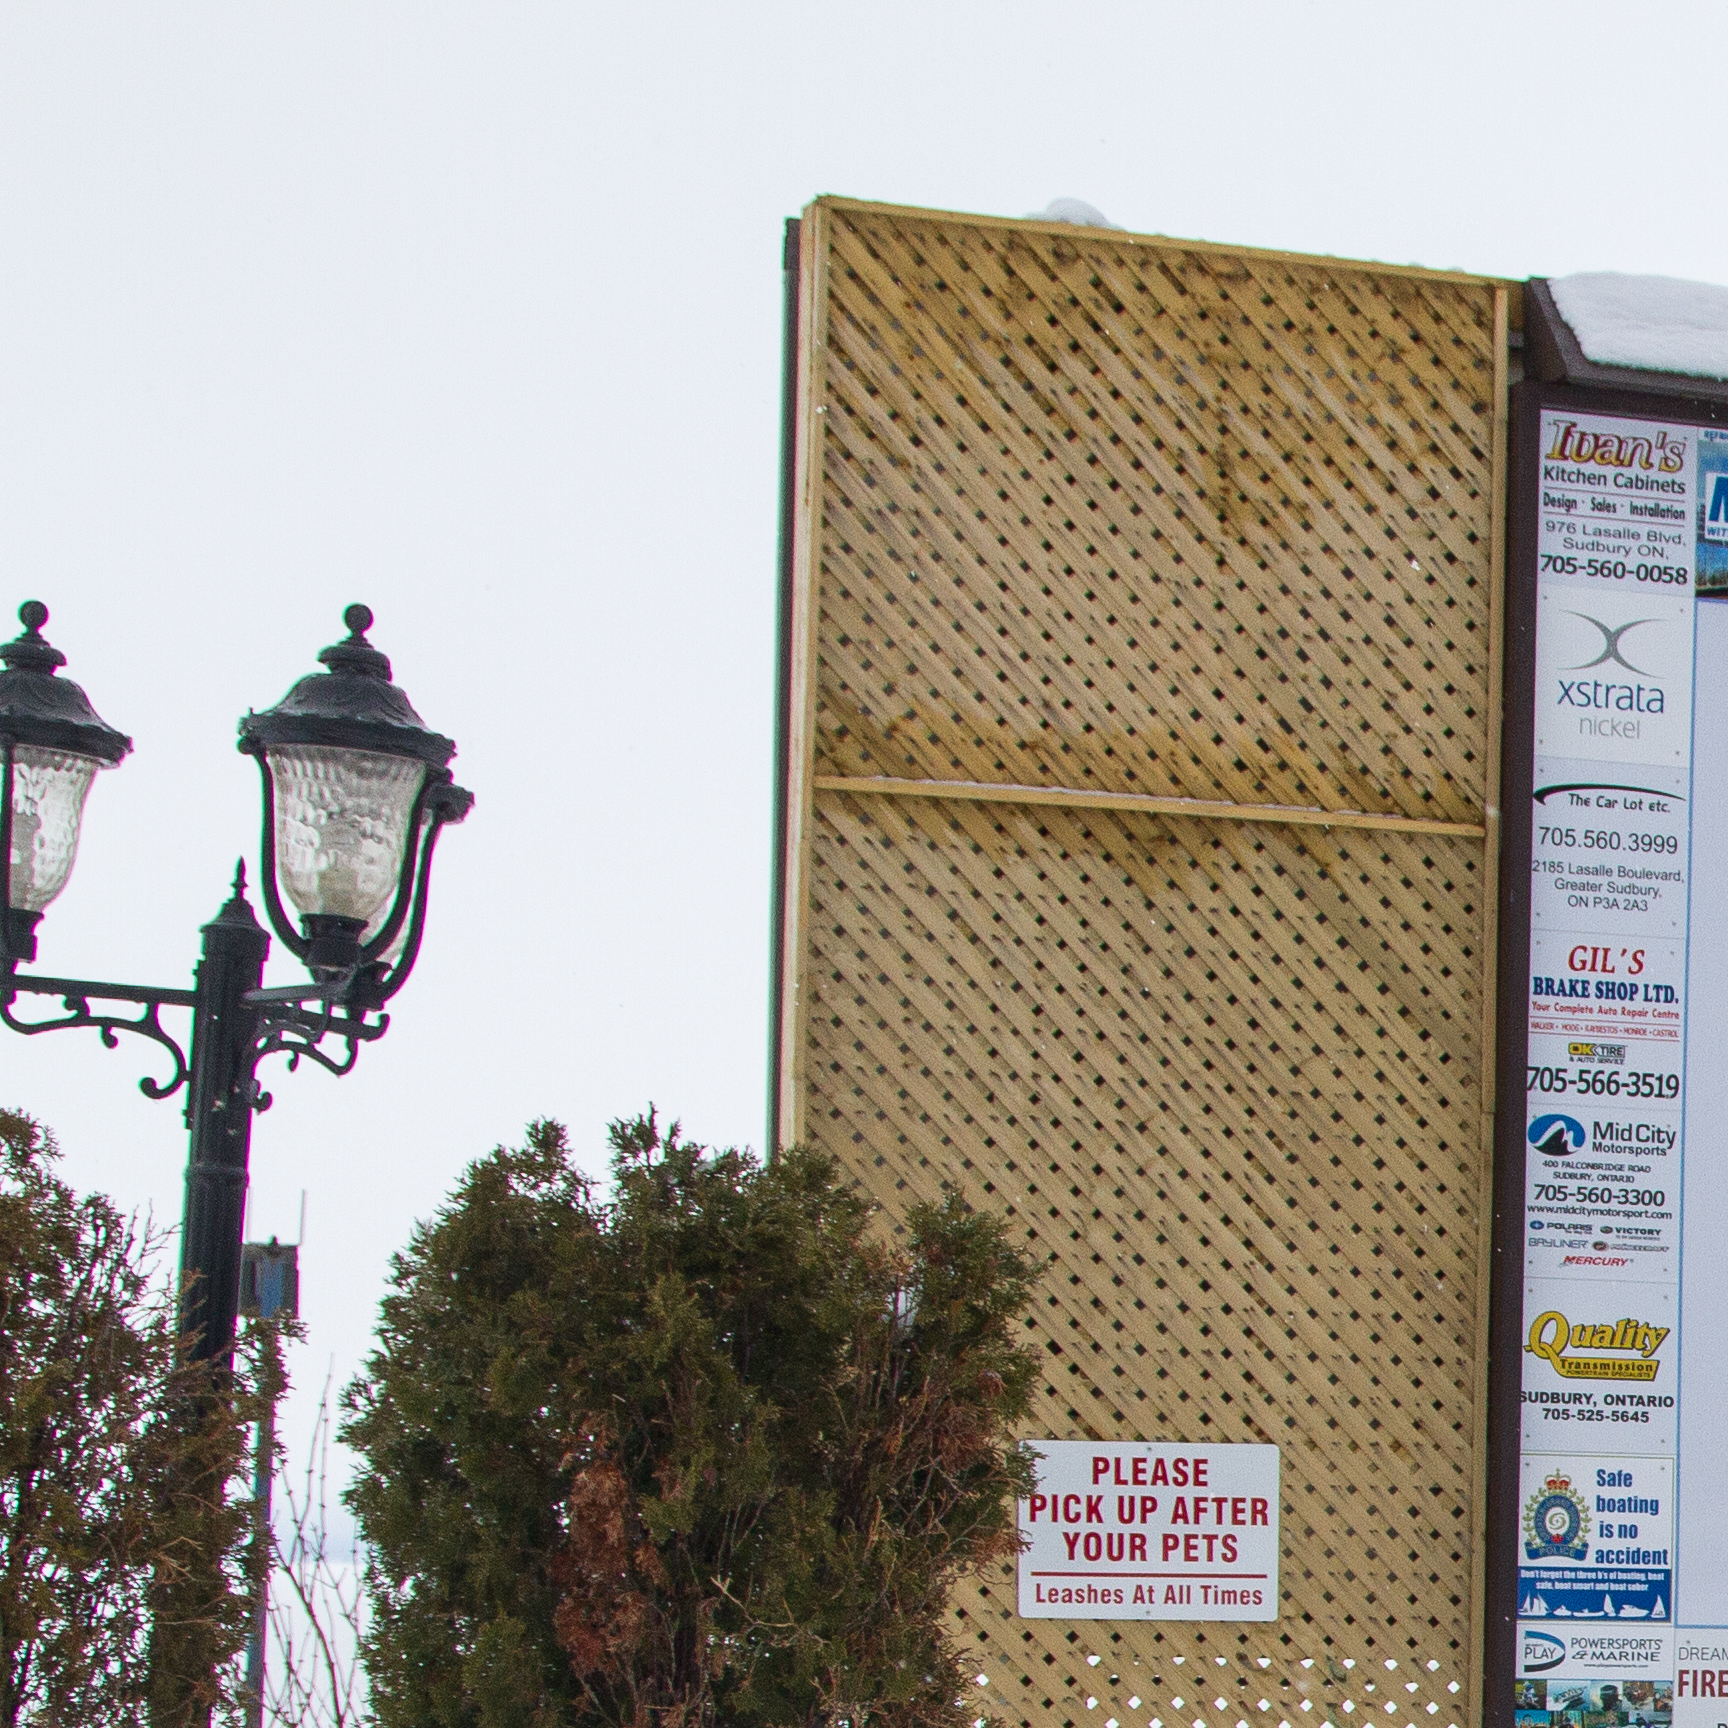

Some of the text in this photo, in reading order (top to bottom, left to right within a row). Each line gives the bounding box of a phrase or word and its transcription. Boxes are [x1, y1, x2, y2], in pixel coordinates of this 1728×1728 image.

[1544, 465, 1686, 494] Kitchen Cabinets
[1543, 492, 1685, 520] Design Sales Installation
[1540, 554, 1688, 585] 705-560-0058
[1557, 679, 1665, 713] xstrata
[1580, 717, 1640, 739] nickel
[1569, 793, 1670, 812] The Car Lot etc.
[1539, 827, 1678, 854] 705.560.3999
[1568, 945, 1645, 974] GIL'S
[1533, 977, 1679, 1004] BRAKE SHOP LTD.
[1601, 1046, 1623, 1056] TIRE
[1527, 1066, 1679, 1099] 705-566-3519
[1592, 1142, 1667, 1156] Motorsports
[1534, 1184, 1665, 1207] 705-560-3300
[1563, 1256, 1628, 1266] MERCURY
[1529, 1311, 1670, 1359] Quality
[1560, 1358, 1653, 1371] Transmission
[1520, 1391, 1674, 1407] SUDBURY, ONTARIO
[1542, 1408, 1649, 1423] 705-525-5645
[1092, 1457, 1209, 1487] PLEASE
[1596, 1469, 1633, 1487] Safe
[1029, 1494, 1269, 1526] PICK UP AFTER
[1596, 1495, 1659, 1516] boating
[1599, 1521, 1638, 1539] is no
[1062, 1532, 1238, 1563] YOUR PETS
[1595, 1547, 1668, 1565] accident
[1035, 1584, 1262, 1606] Leashes At All Times
[1524, 1647, 1556, 1660] PLAY
[1571, 1638, 1662, 1650] POWERSPORTS
[1591, 1651, 1661, 1662] MARINE
